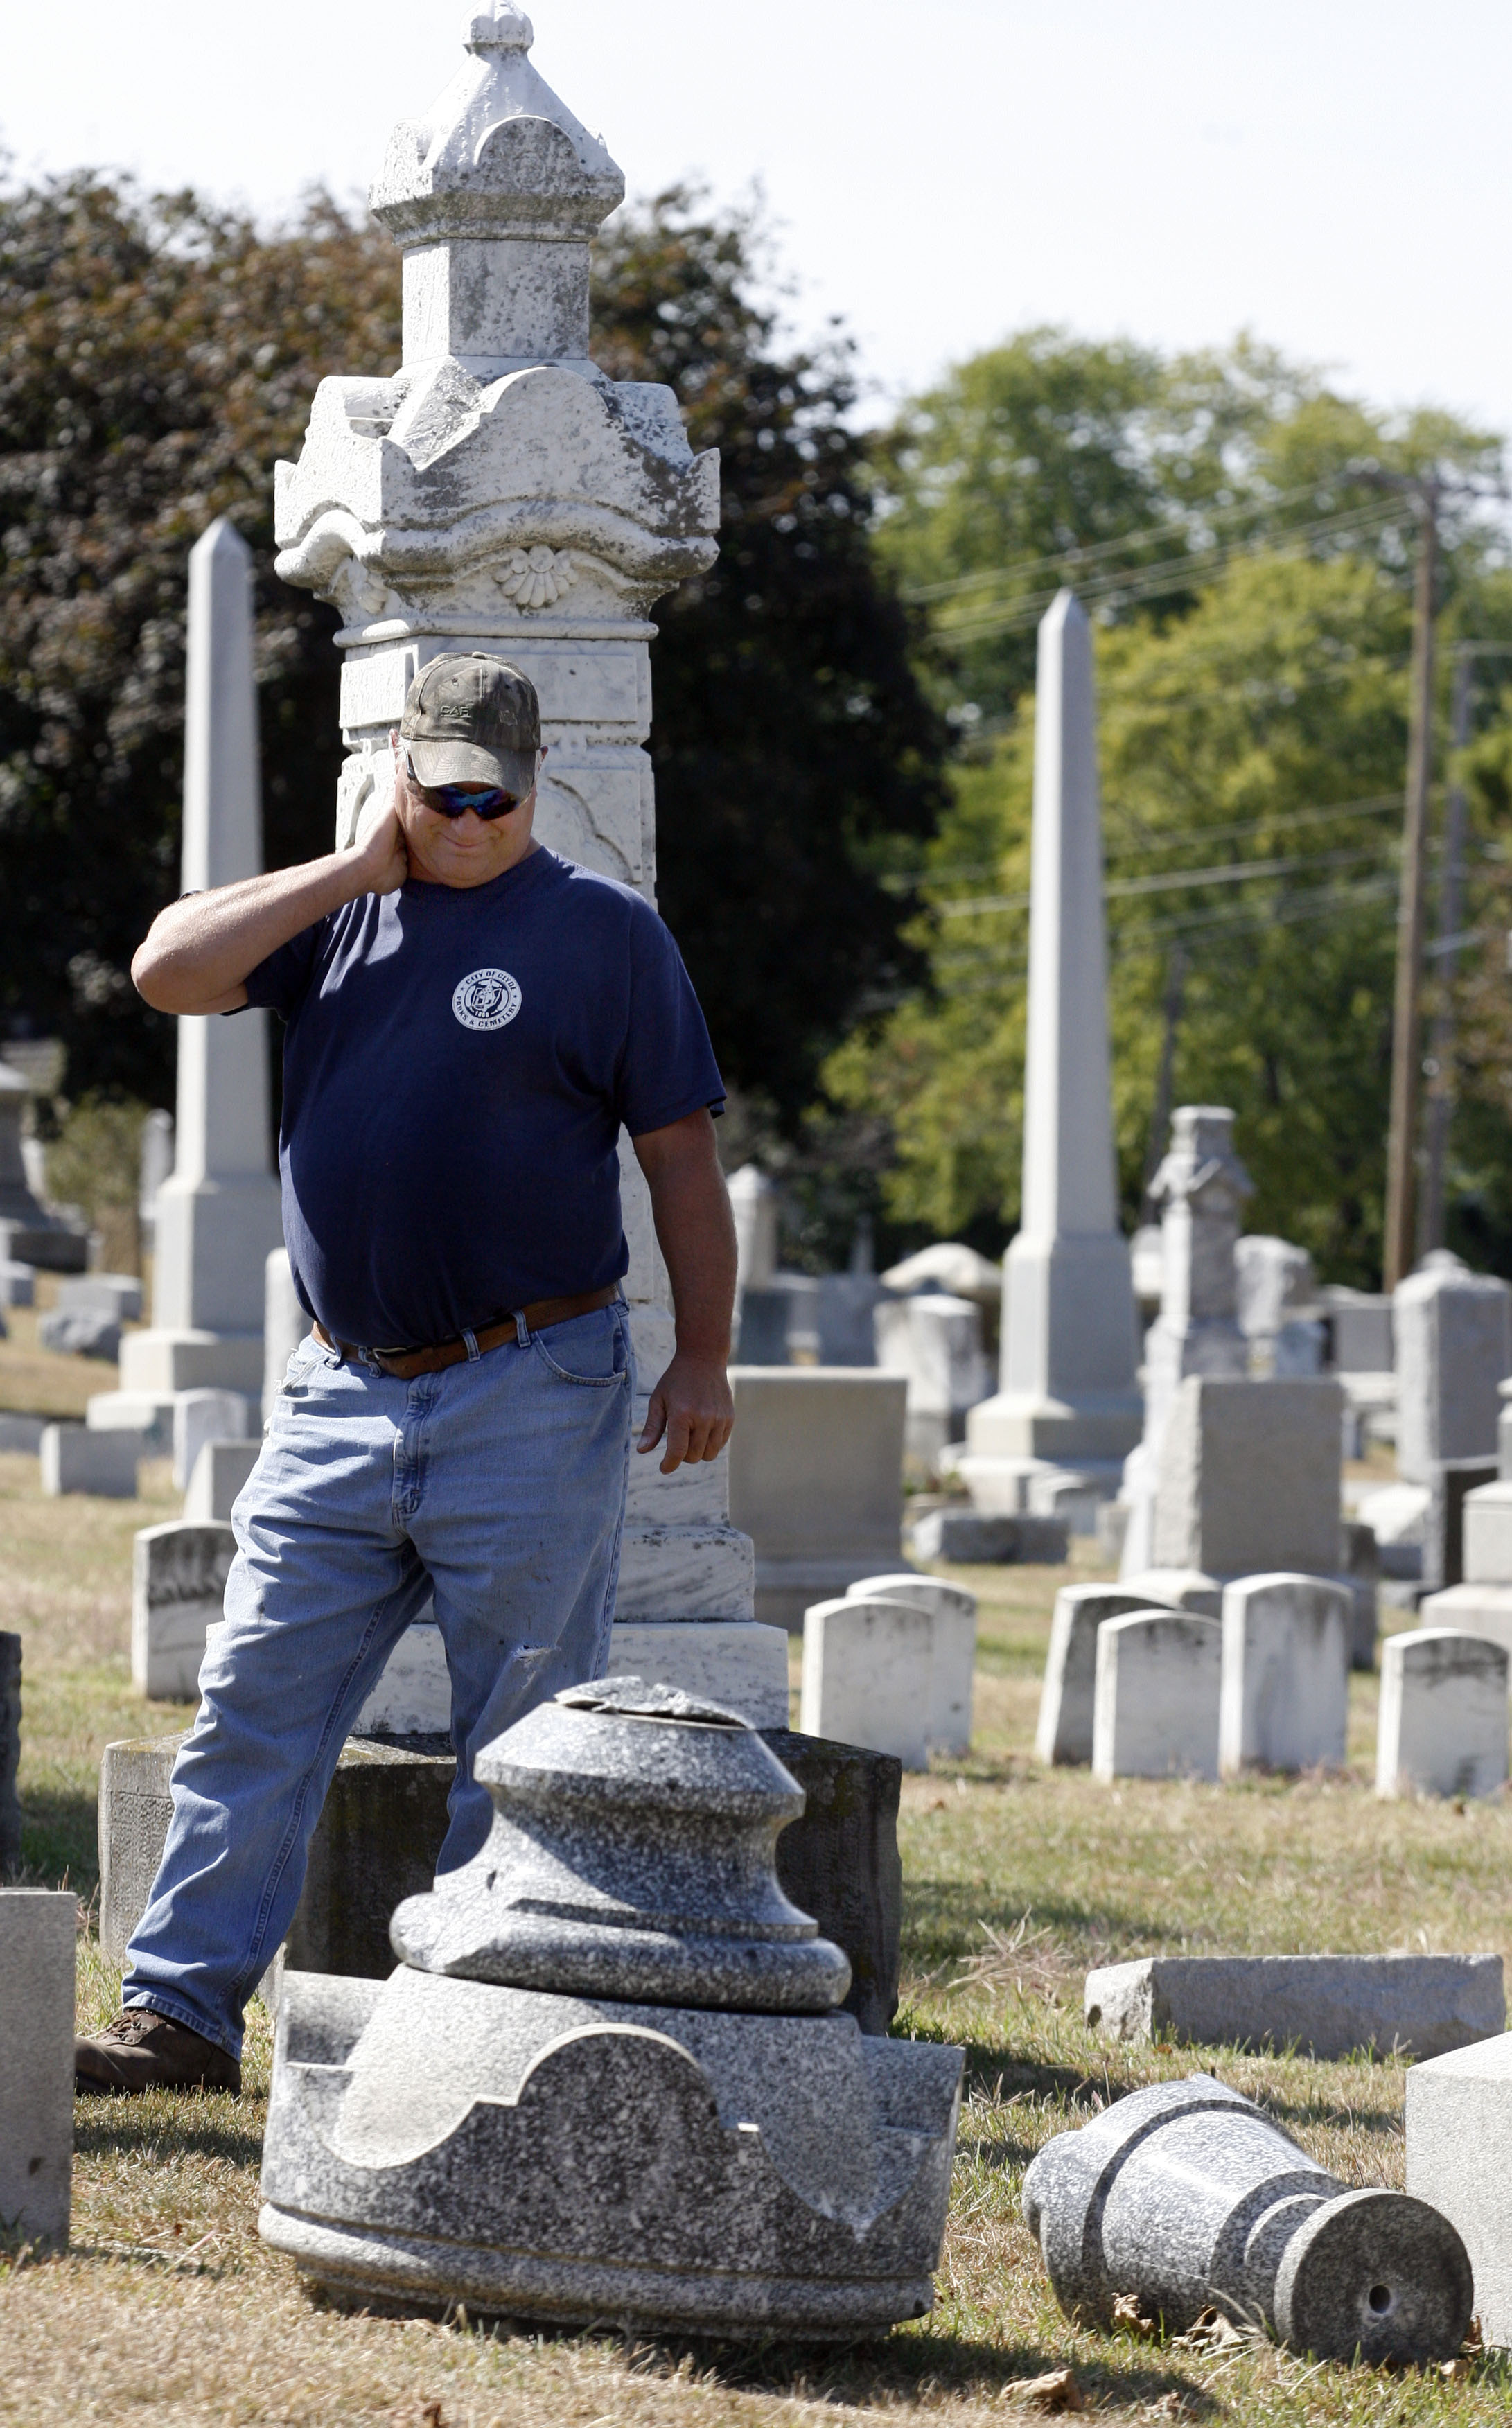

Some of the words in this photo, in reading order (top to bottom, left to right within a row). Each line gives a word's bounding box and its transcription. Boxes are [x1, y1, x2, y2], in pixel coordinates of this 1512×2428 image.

[465, 971, 483, 985] CITY
[498, 972, 517, 991] CLYDE
[456, 996, 468, 1021] PARKS
[478, 1003, 517, 1027] CEMETERY
